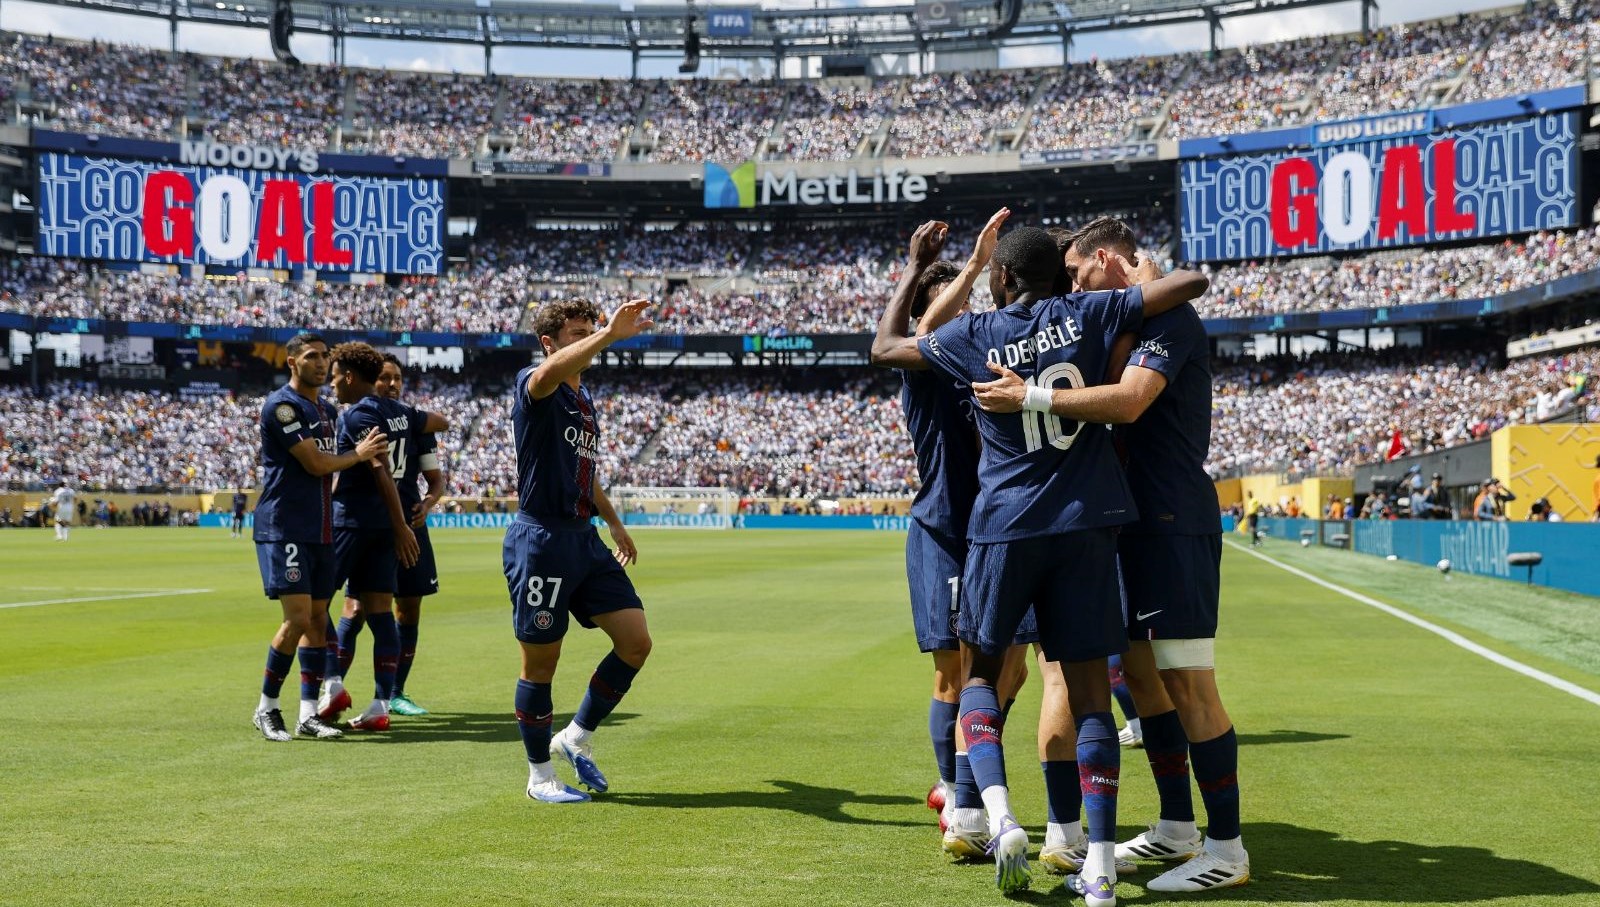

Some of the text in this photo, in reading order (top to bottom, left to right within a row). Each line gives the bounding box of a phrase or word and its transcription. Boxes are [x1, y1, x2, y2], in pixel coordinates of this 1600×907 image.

[713, 15, 744, 27] FIFA
[1318, 114, 1425, 142] BUD LIGHT
[181, 141, 319, 173] MOODY'S
[761, 168, 928, 204] MetLife
[1270, 139, 1475, 248] GOAL
[143, 171, 353, 265] GOAL
[764, 336, 813, 349] MetLife
[1022, 362, 1086, 453] 10
[564, 426, 600, 451] QATA
[388, 437, 408, 478] 14
[432, 512, 517, 528] visitQATA
[285, 543, 299, 567] 2
[527, 575, 562, 609] 87
[971, 724, 999, 736] PARIS
[1091, 775, 1119, 787] PARIS
